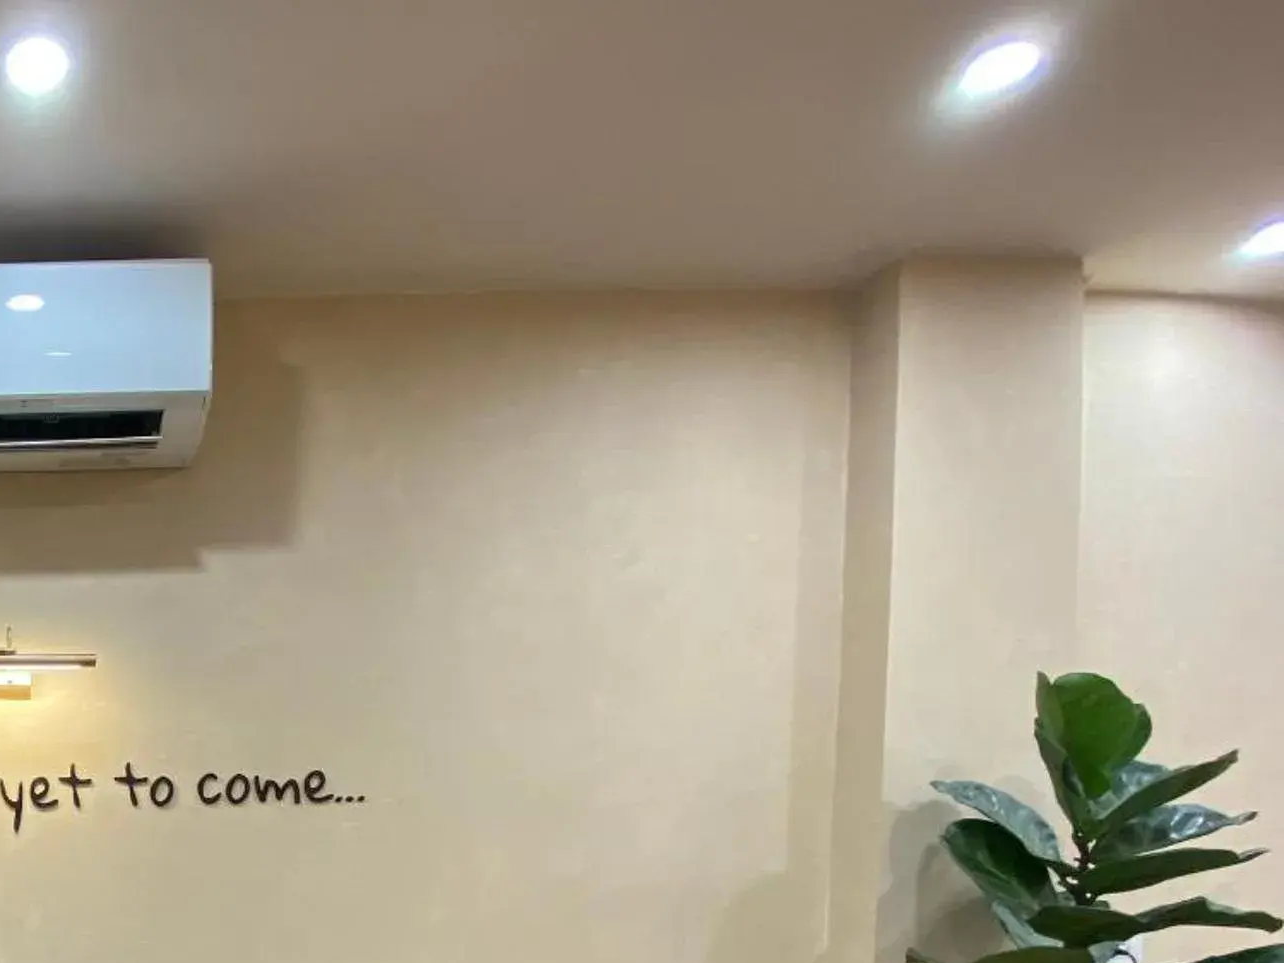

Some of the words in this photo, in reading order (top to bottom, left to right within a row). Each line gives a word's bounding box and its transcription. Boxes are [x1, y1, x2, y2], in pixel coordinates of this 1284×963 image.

[0, 763, 93, 834] yet
[113, 761, 175, 809] to
[196, 769, 366, 806] come...
